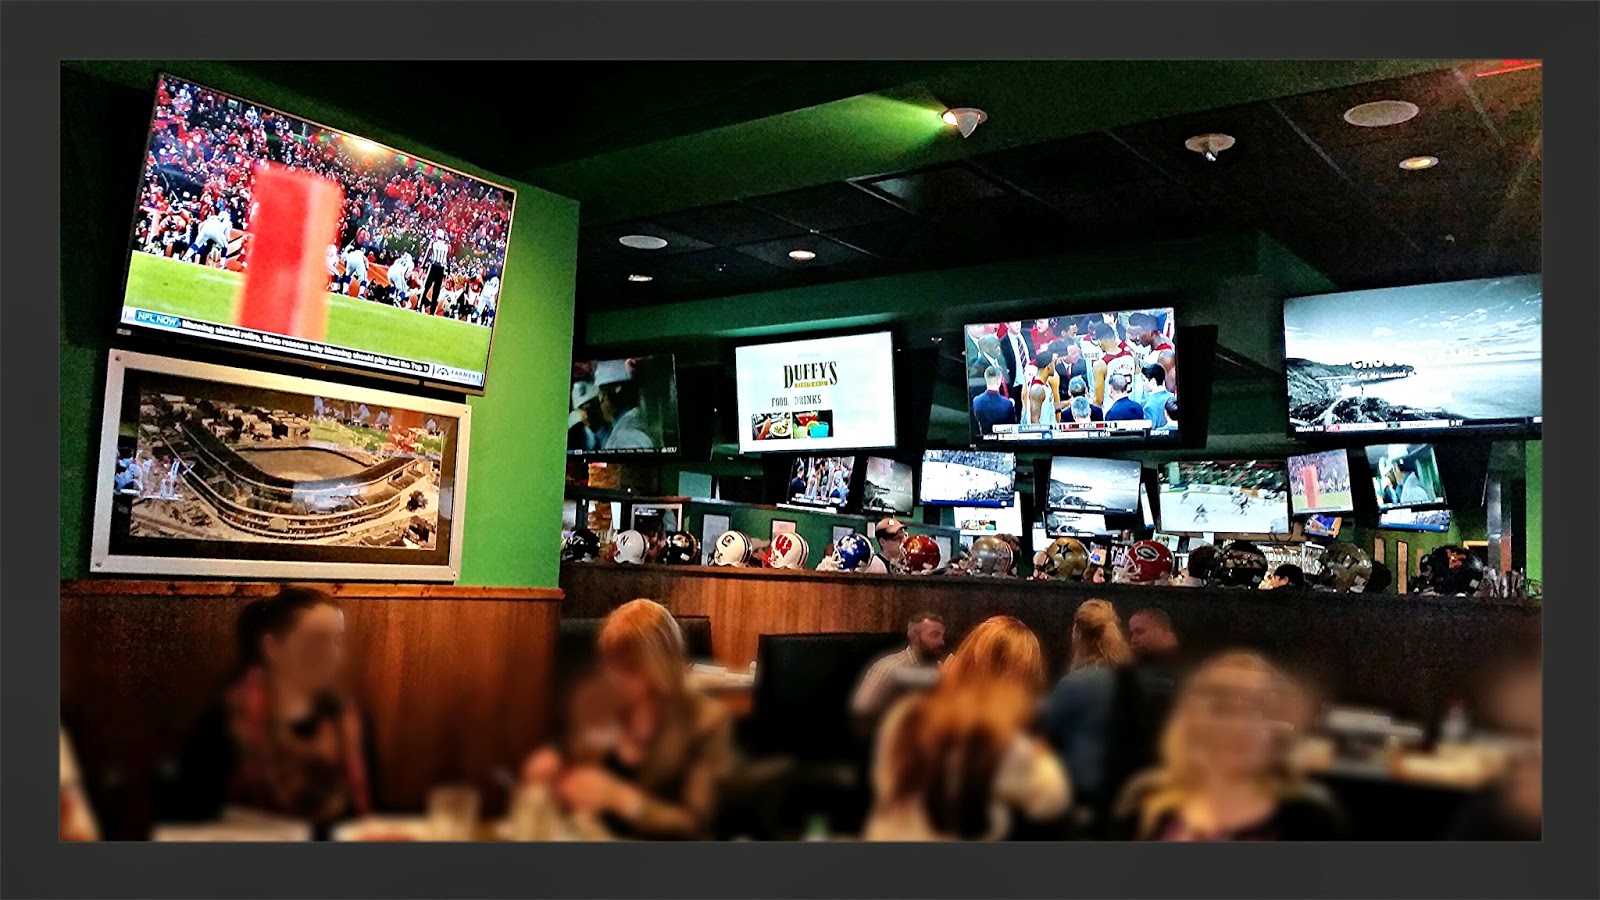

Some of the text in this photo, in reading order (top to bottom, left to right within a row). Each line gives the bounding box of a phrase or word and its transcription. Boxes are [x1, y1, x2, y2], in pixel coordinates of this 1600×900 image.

[138, 312, 178, 326] NFL NOW
[215, 326, 240, 339] should
[310, 344, 324, 354] why
[352, 351, 374, 362] should
[451, 370, 480, 380] FARMERS
[783, 361, 838, 389] DUFFY'S
[795, 394, 822, 405] DRINKS
